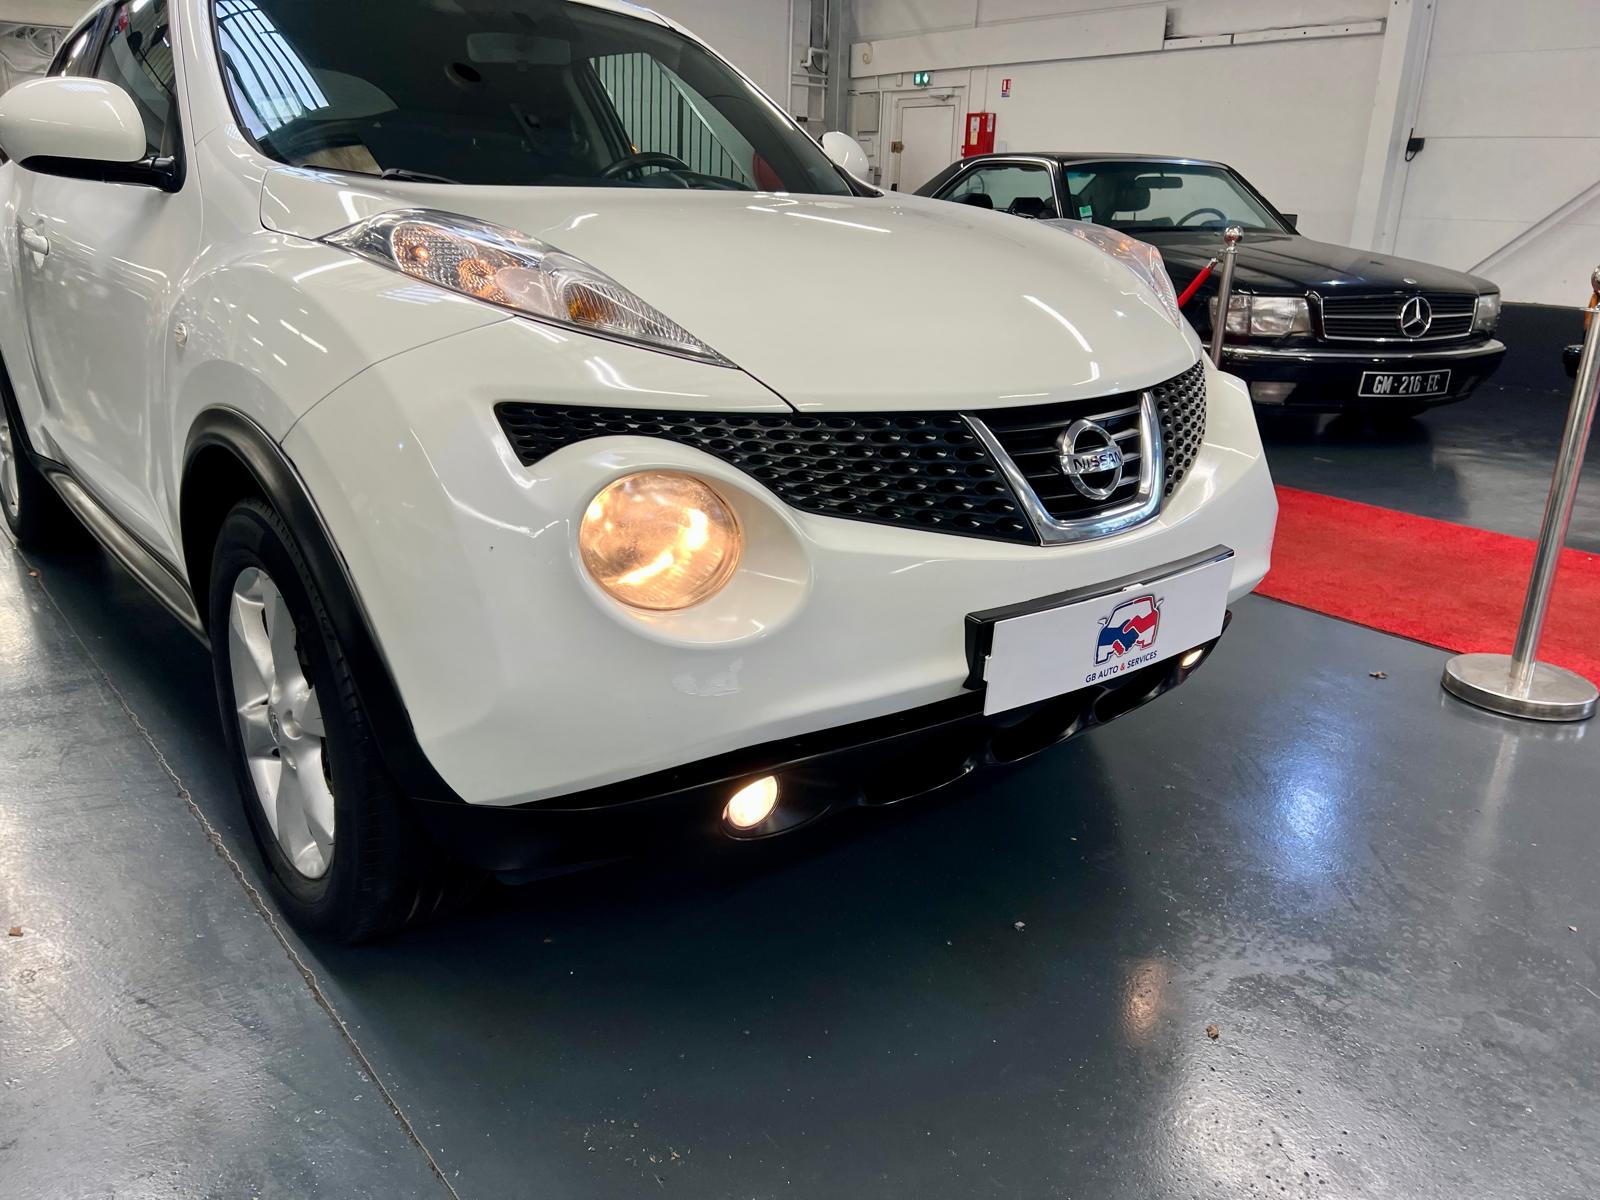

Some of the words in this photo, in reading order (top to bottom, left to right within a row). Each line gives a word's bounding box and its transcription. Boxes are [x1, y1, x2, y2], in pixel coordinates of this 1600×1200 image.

[1373, 375, 1393, 394] GM
[1399, 375, 1422, 394] 216
[1073, 451, 1121, 470] NISSAN
[1085, 673, 1097, 683] GB
[1098, 665, 1119, 680] AUTO
[1120, 662, 1126, 672] &
[1127, 650, 1158, 669] SERVICES
